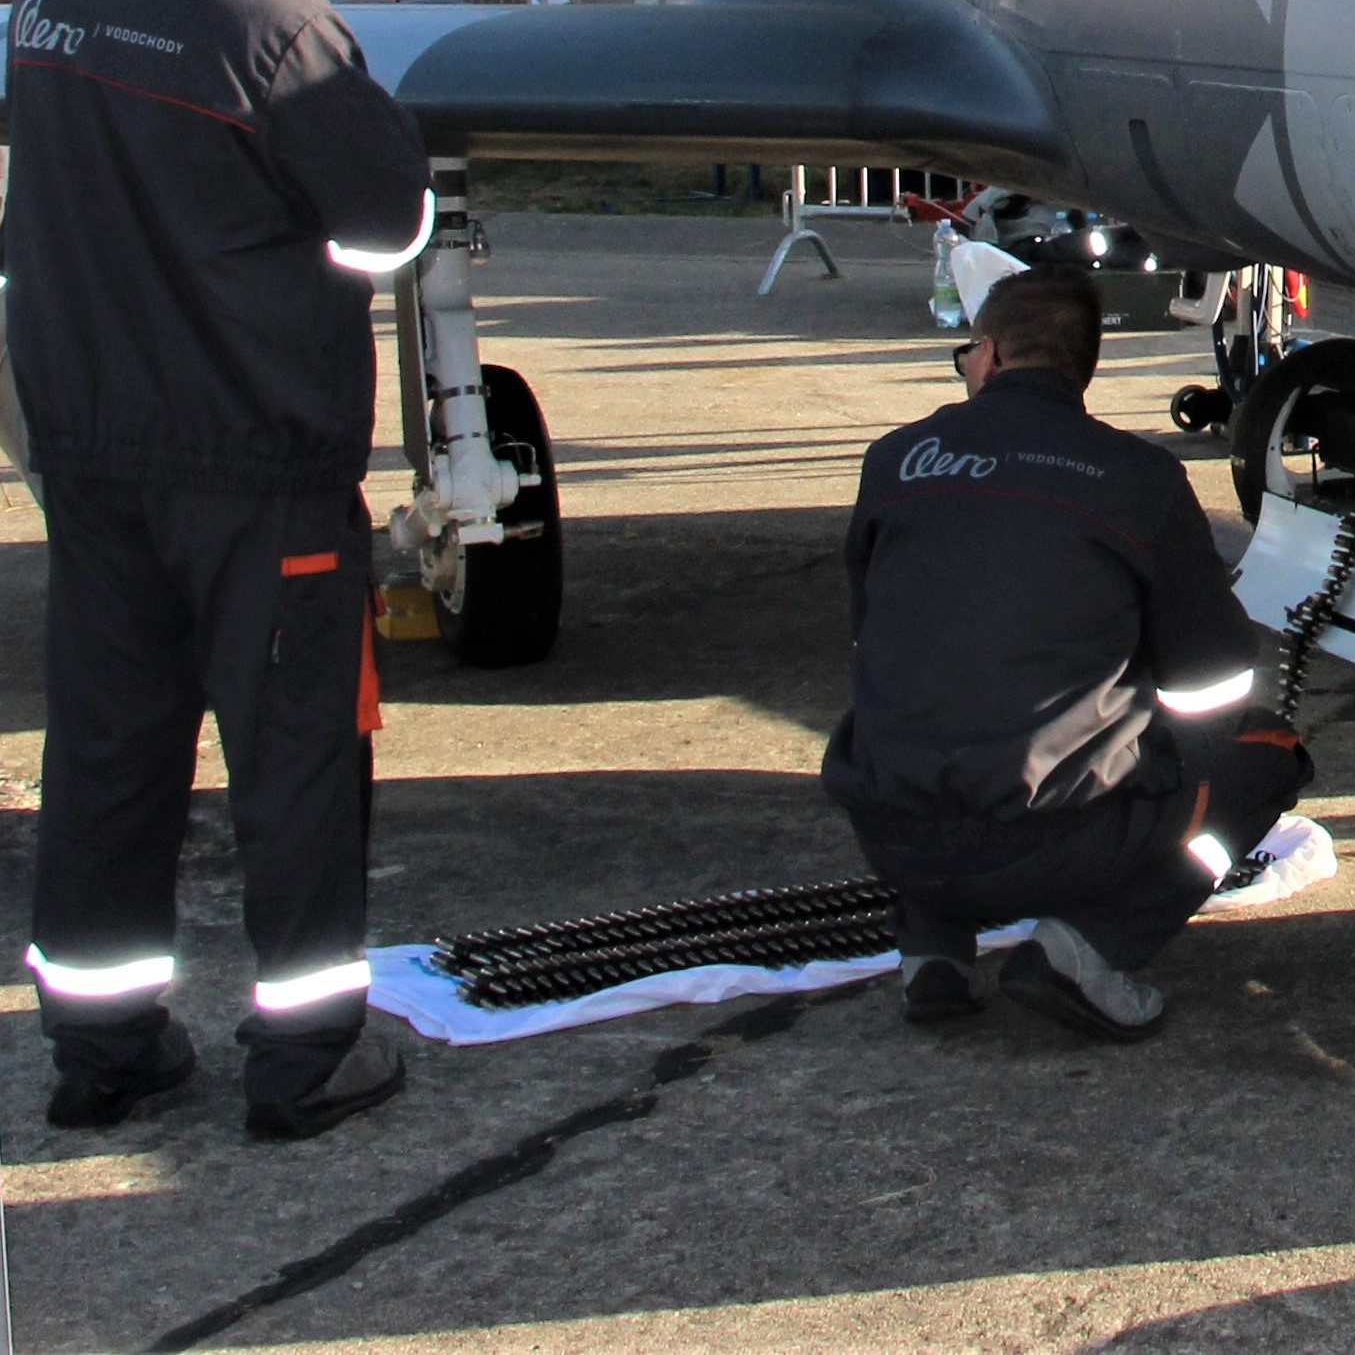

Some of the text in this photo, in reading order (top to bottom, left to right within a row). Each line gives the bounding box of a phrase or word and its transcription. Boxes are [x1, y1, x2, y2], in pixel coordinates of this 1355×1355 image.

[105, 24, 184, 55] VODOCHODY
[900, 437, 1104, 481] Aero VODOCHODY
